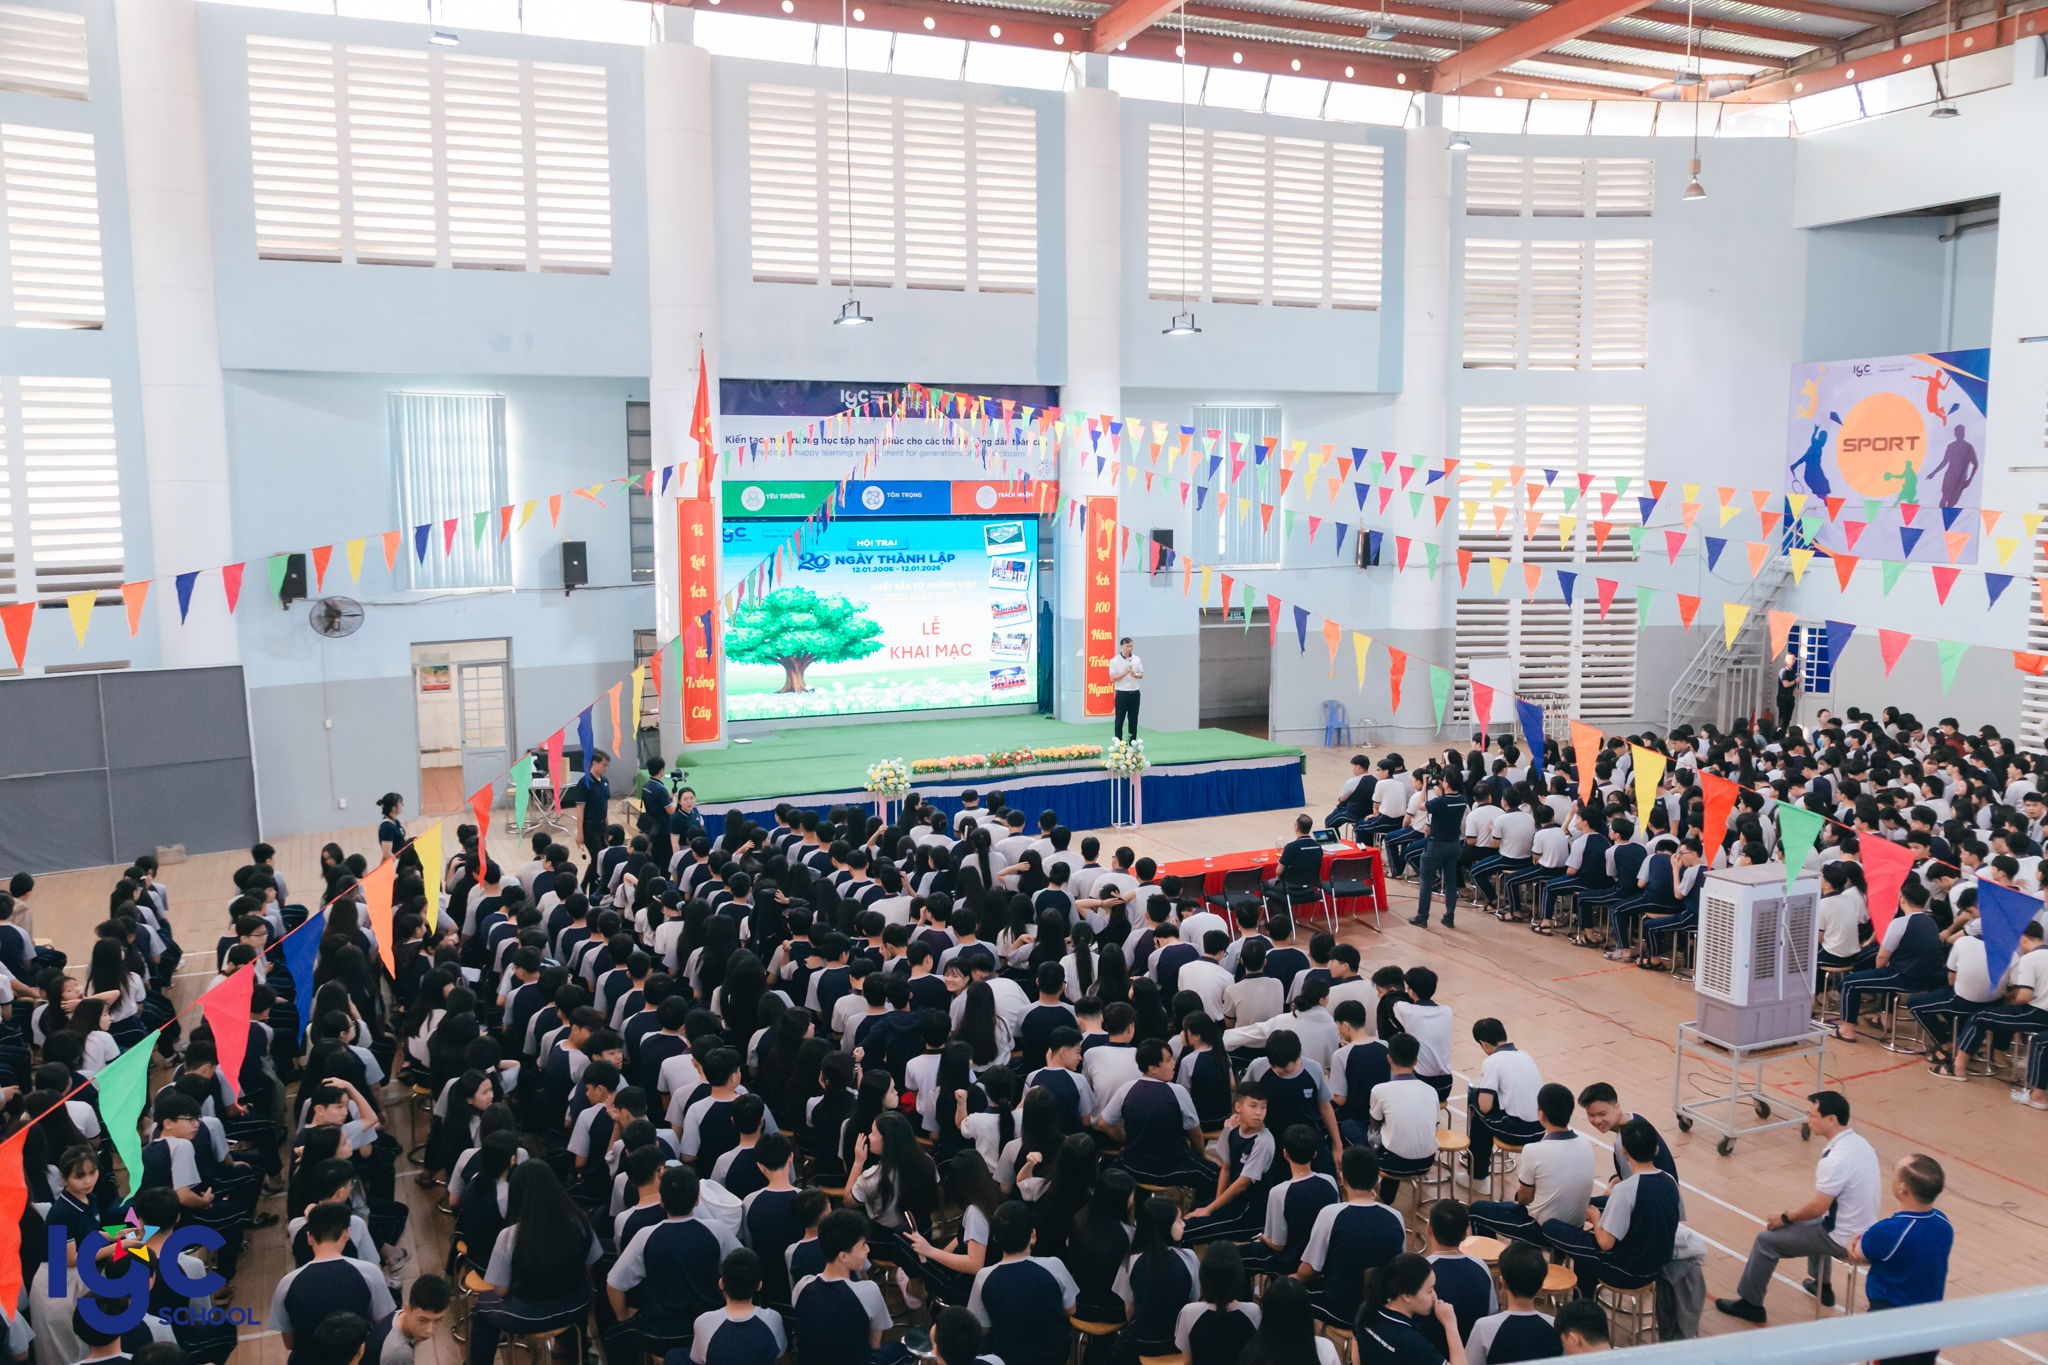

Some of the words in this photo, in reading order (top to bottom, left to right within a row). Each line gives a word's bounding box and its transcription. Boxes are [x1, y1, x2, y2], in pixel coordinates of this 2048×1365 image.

[725, 433, 746, 444] Kiến
[769, 435, 785, 444] mi
[840, 435, 856, 446] tập
[906, 436, 923, 445] cho
[1842, 435, 1920, 453] SPORT
[857, 538, 873, 547] HỘI
[835, 552, 874, 565] NGÀY
[877, 552, 925, 564] THÀNH
[929, 551, 955, 565] LẬP
[1094, 601, 1111, 613] 100
[922, 616, 940, 635] LỄ
[1091, 629, 1112, 640] Năm
[890, 645, 929, 660] KHAI
[935, 643, 972, 660] MẠC
[691, 706, 712, 721] Cây
